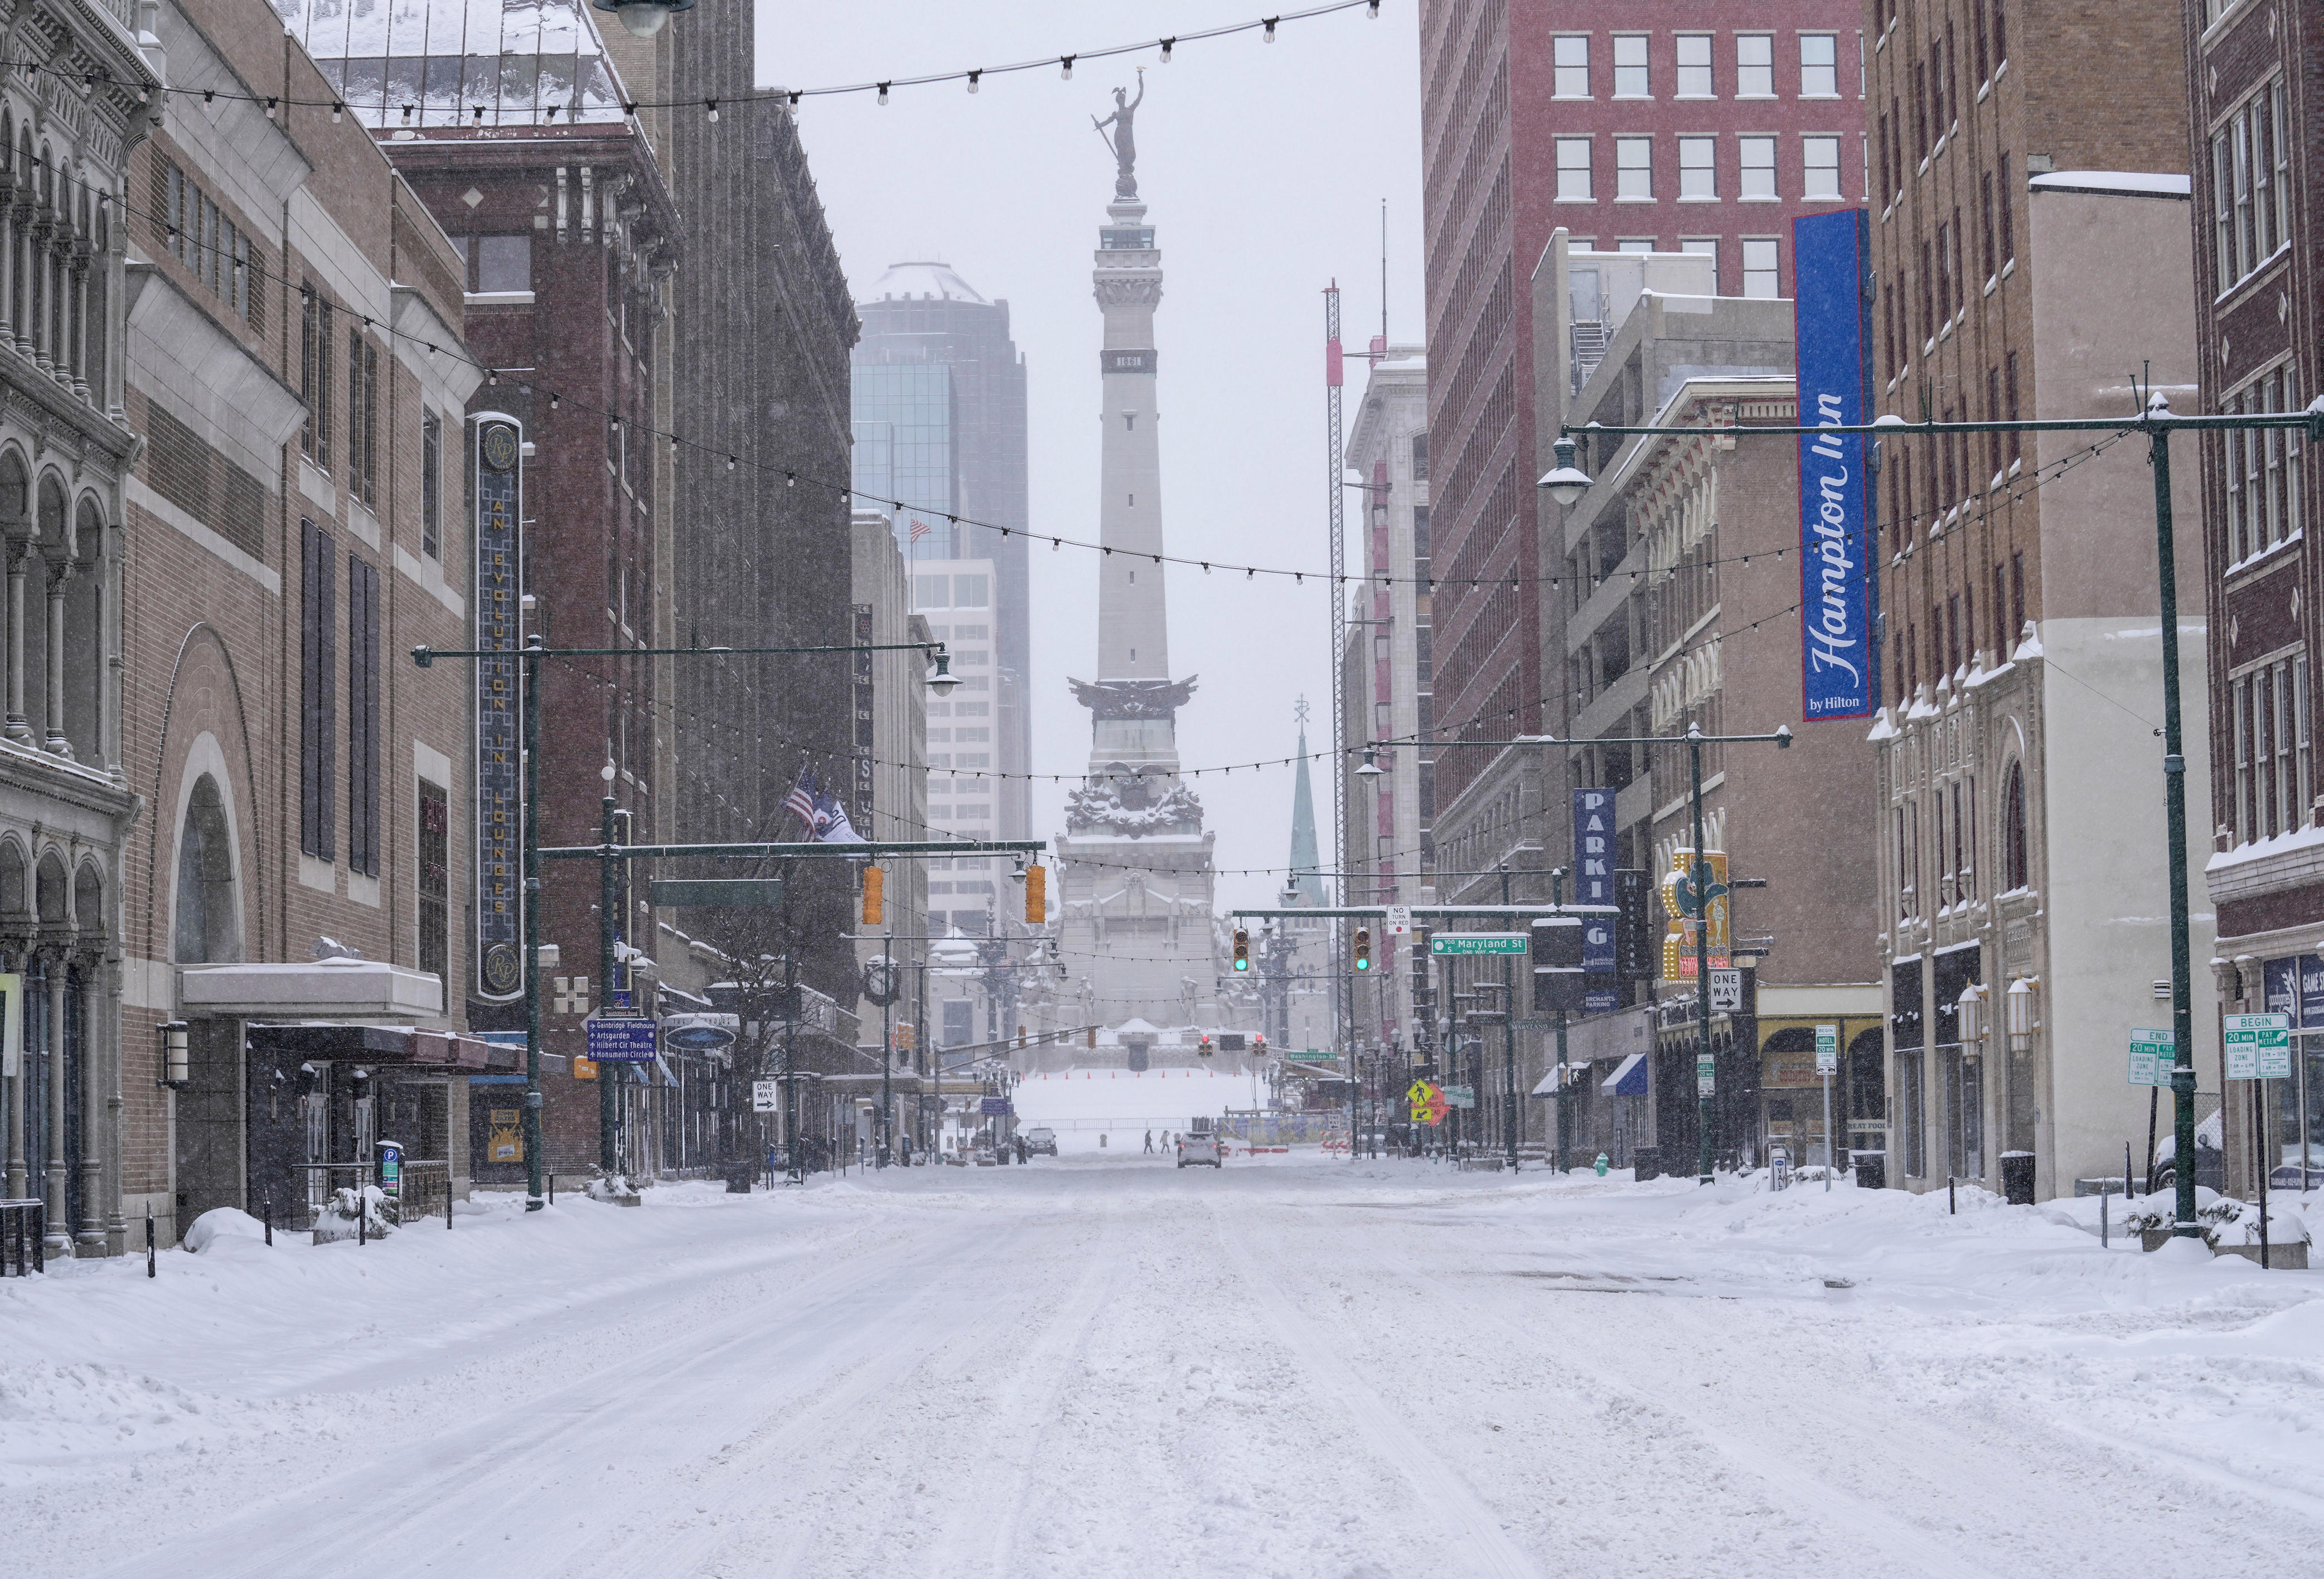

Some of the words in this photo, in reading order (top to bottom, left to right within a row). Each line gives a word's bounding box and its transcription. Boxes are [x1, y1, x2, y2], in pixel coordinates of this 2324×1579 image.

[1121, 357, 1138, 365] 1861
[1812, 393, 1842, 459] Inn
[493, 500, 504, 530] AN
[1809, 465, 1859, 688] Hampton
[1810, 699, 1823, 713] by
[1824, 697, 1860, 709] Hilton
[494, 733, 505, 764] IN
[493, 792, 506, 913] LOUNGES
[1585, 793, 1608, 944] PARKIG
[1458, 939, 1507, 950] Maryland
[1512, 939, 1522, 948] St
[1714, 975, 1737, 984] ONE
[2302, 972, 2319, 993] GAME
[1713, 987, 1738, 996] WAY
[597, 1022, 625, 1030] Gainbridge
[2240, 1017, 2272, 1027] BEGIN
[597, 1032, 630, 1040] Artsgarden
[2149, 1032, 2168, 1041] END
[2228, 1033, 2239, 1042] 20
[2132, 1043, 2143, 1052] 20
[388, 1151, 394, 1160] P
